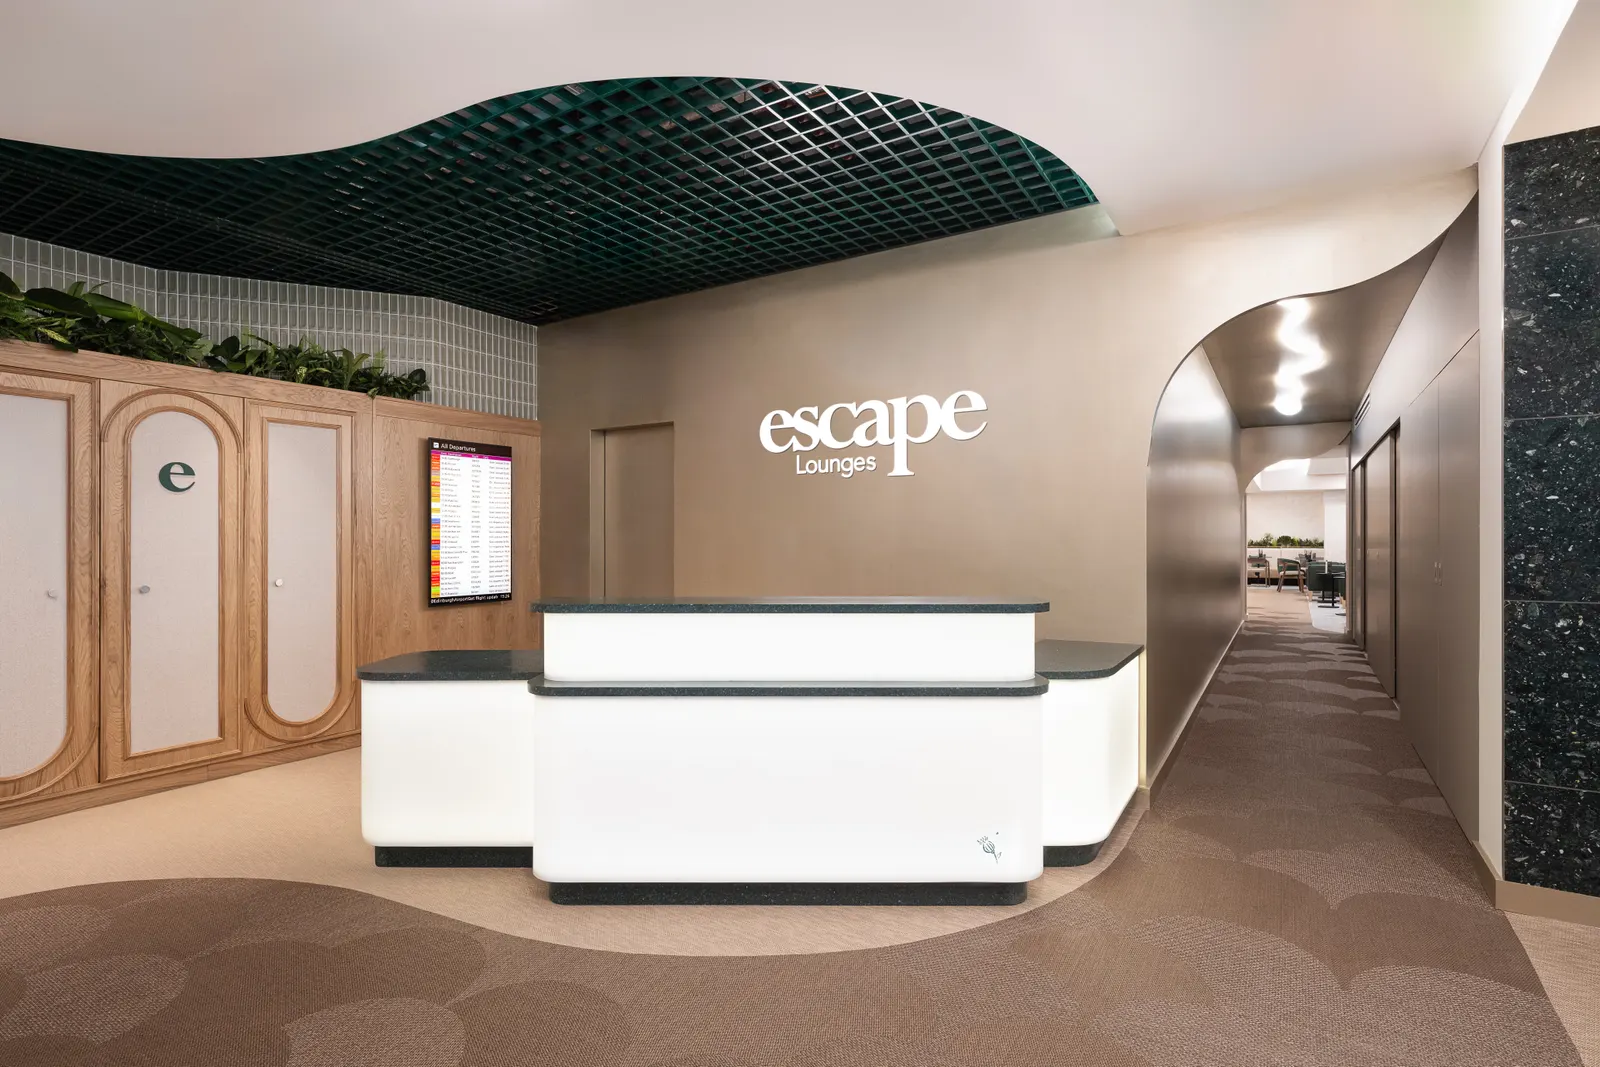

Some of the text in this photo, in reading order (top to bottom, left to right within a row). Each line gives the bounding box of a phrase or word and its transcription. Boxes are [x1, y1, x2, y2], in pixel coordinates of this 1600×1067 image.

[759, 390, 988, 477] escape
[449, 443, 476, 452] Departures
[159, 462, 196, 493] e
[796, 455, 877, 478] Lounges
